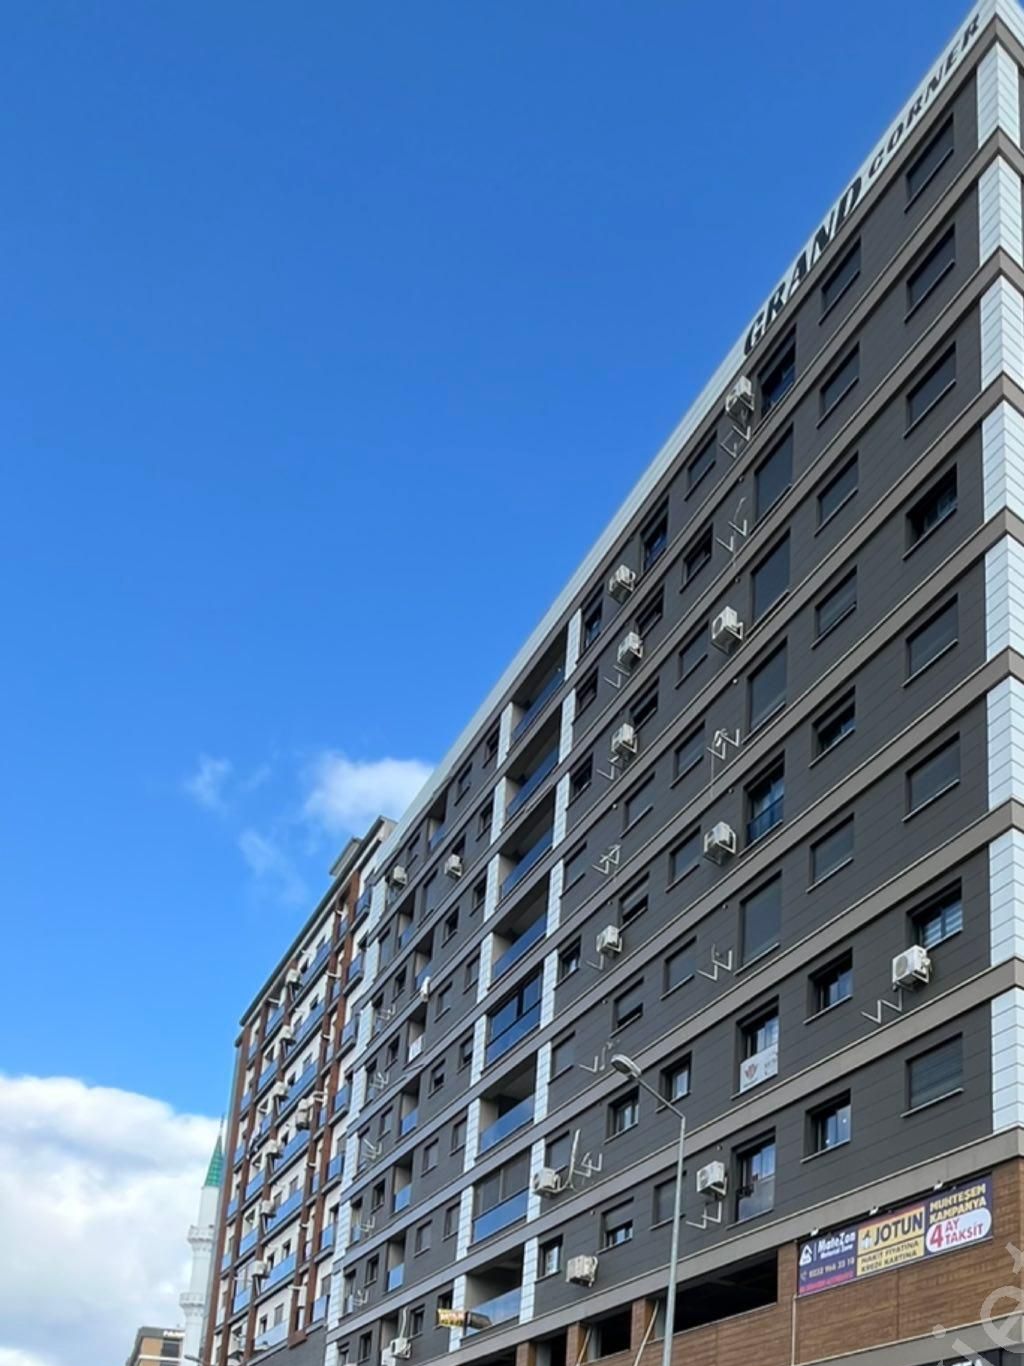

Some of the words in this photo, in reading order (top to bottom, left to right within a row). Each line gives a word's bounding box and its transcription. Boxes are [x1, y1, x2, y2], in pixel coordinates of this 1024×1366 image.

[743, 177, 862, 356] GRAND
[867, 13, 980, 178] CORNER
[874, 1211, 923, 1246] JOTUN
[929, 1223, 944, 1249] 4
[945, 1218, 960, 1233] AY
